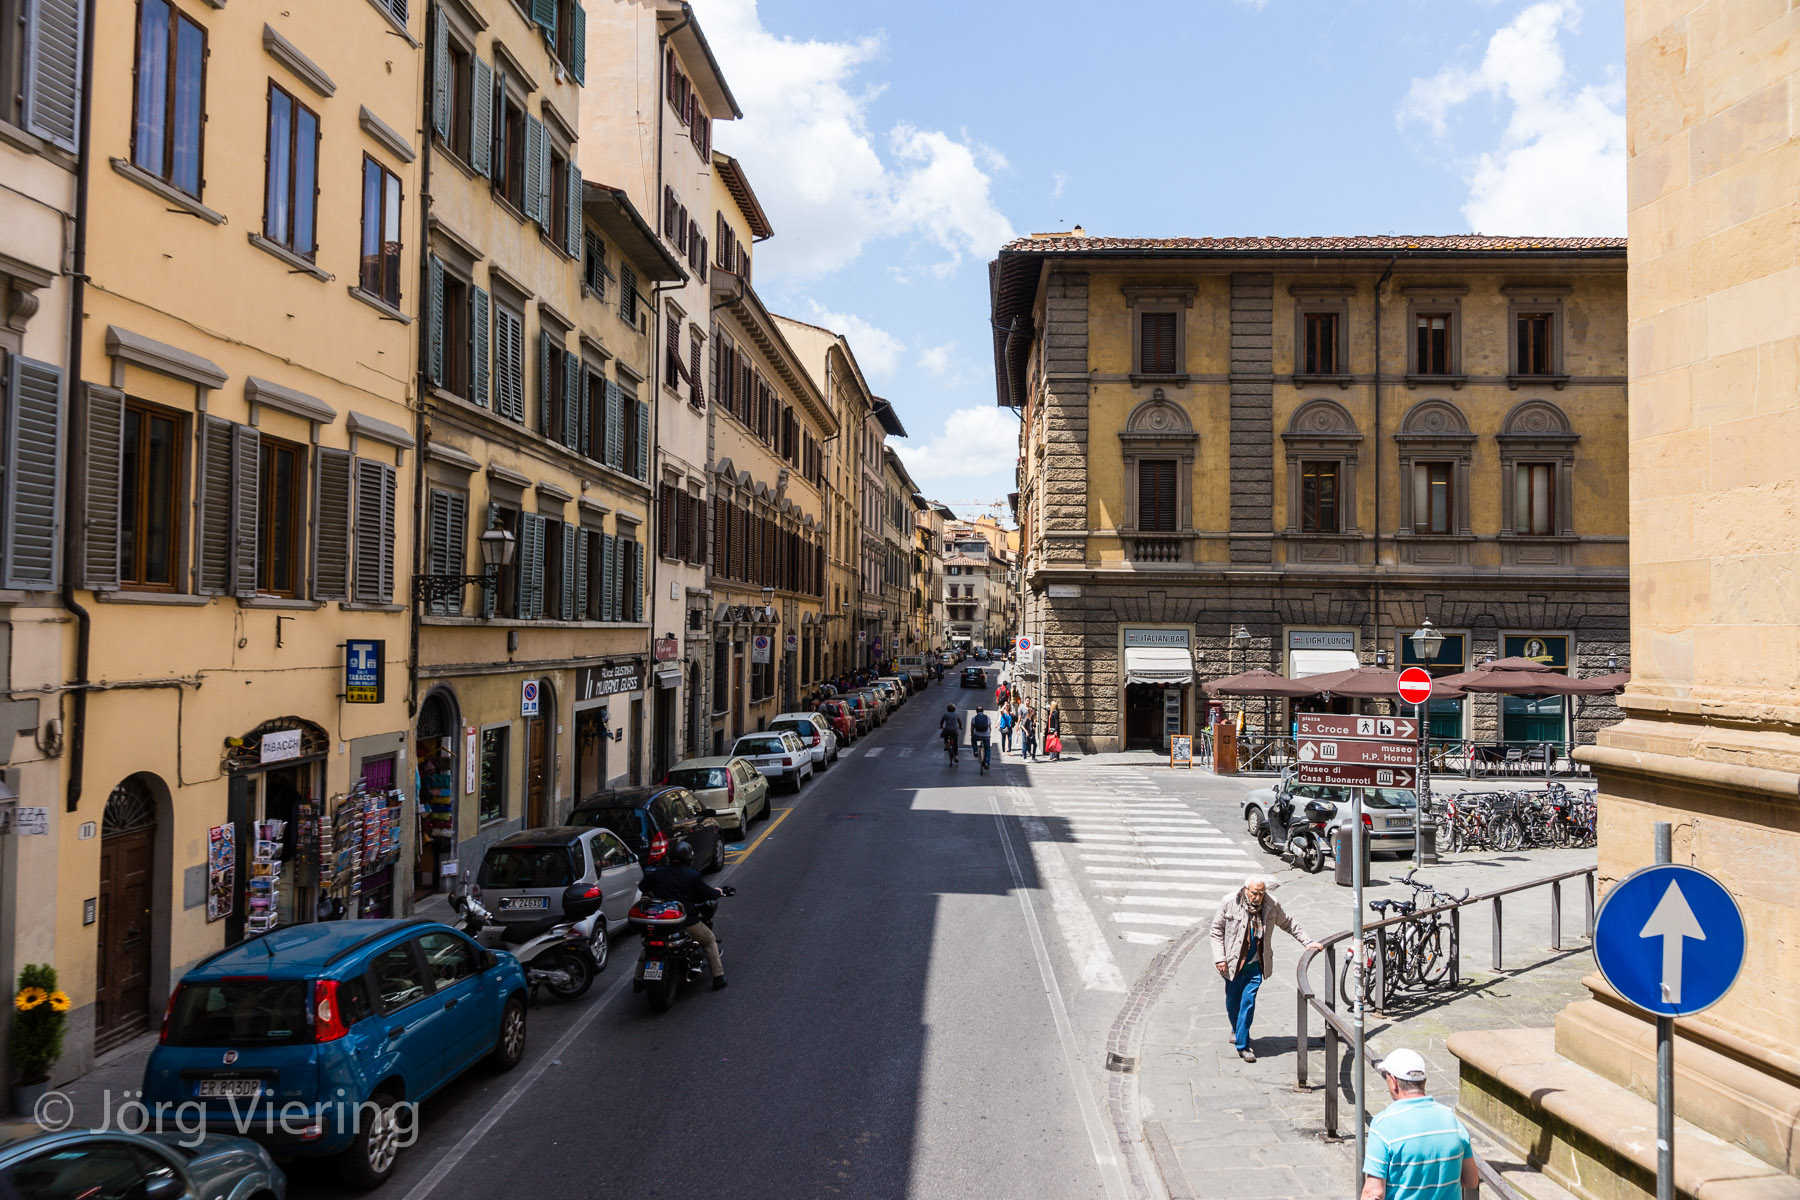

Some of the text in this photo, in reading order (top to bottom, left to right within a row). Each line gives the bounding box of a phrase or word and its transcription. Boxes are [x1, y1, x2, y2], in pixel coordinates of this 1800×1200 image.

[1141, 634, 1168, 642] ITALIAN
[1170, 635, 1185, 643] BAR
[1305, 636, 1326, 644] LIGHT
[1327, 637, 1351, 645] LUNCH
[595, 676, 638, 696] MURANO GLASS
[1301, 723, 1350, 735] S. Croce
[1381, 745, 1413, 753] museo
[1362, 752, 1413, 763] H.P. Horne
[1301, 765, 1341, 774] Museo di
[1300, 774, 1371, 785] Casa Buonarroti
